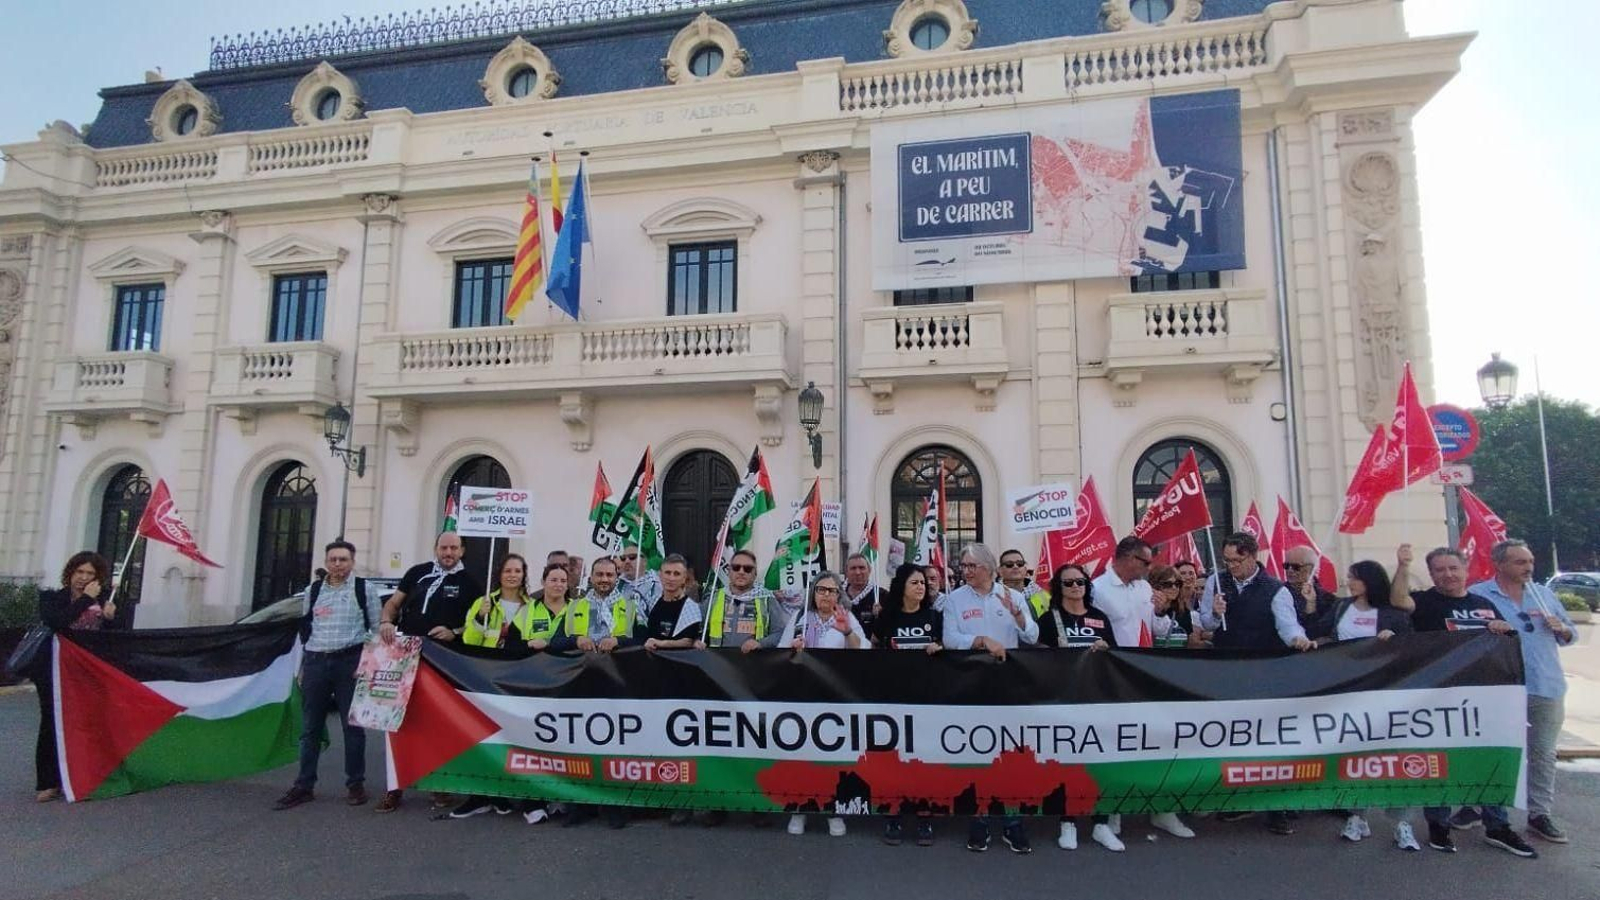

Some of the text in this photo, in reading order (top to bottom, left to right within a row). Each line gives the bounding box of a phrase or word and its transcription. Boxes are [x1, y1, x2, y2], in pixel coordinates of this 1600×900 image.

[645, 111, 664, 124] DE
[911, 147, 1019, 175] EL MARÍTIM,
[939, 177, 990, 199] A PEU
[917, 201, 1015, 226] DE CARRER
[495, 491, 528, 502] STOP
[1038, 490, 1068, 503] STOP
[463, 504, 496, 514] COMERÇ
[1014, 507, 1072, 523] GENOCIDI
[488, 515, 527, 526] ISRAEL
[897, 627, 924, 637] NO
[1066, 627, 1095, 636] NO
[375, 671, 401, 681] STOP
[534, 700, 1481, 754] STOP GENOCIDI CONTRA EL POBLE PALESTÍ!
[511, 754, 567, 773] CCOO
[610, 759, 656, 781] UGT
[1346, 756, 1399, 779] UGT
[1227, 765, 1294, 783] CCOO
